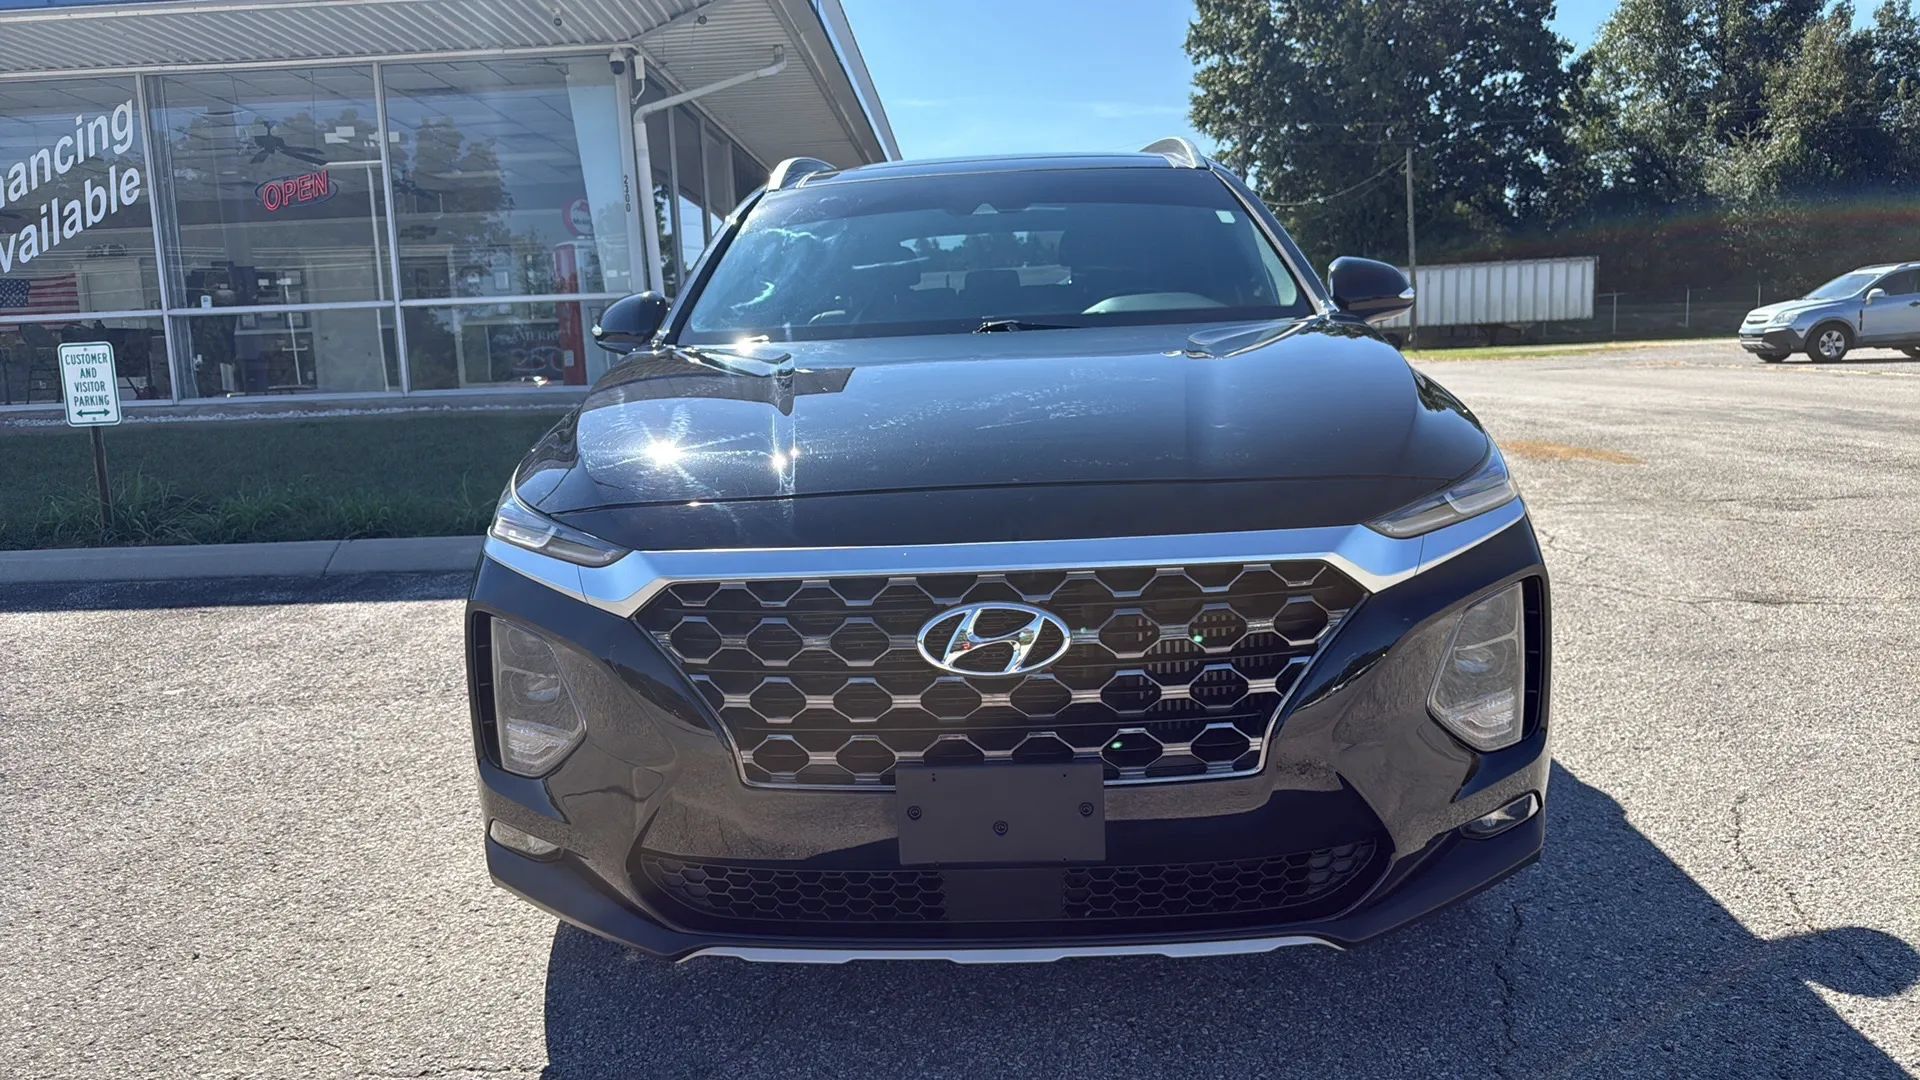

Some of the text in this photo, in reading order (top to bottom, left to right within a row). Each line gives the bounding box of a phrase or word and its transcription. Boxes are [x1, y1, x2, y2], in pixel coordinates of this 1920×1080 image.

[263, 169, 328, 212] OPEN
[0, 165, 141, 273] vailable
[65, 352, 108, 365] CUSTOMER
[80, 367, 97, 378] AND
[74, 380, 106, 392] VISITOR
[74, 394, 110, 407] PARKING
